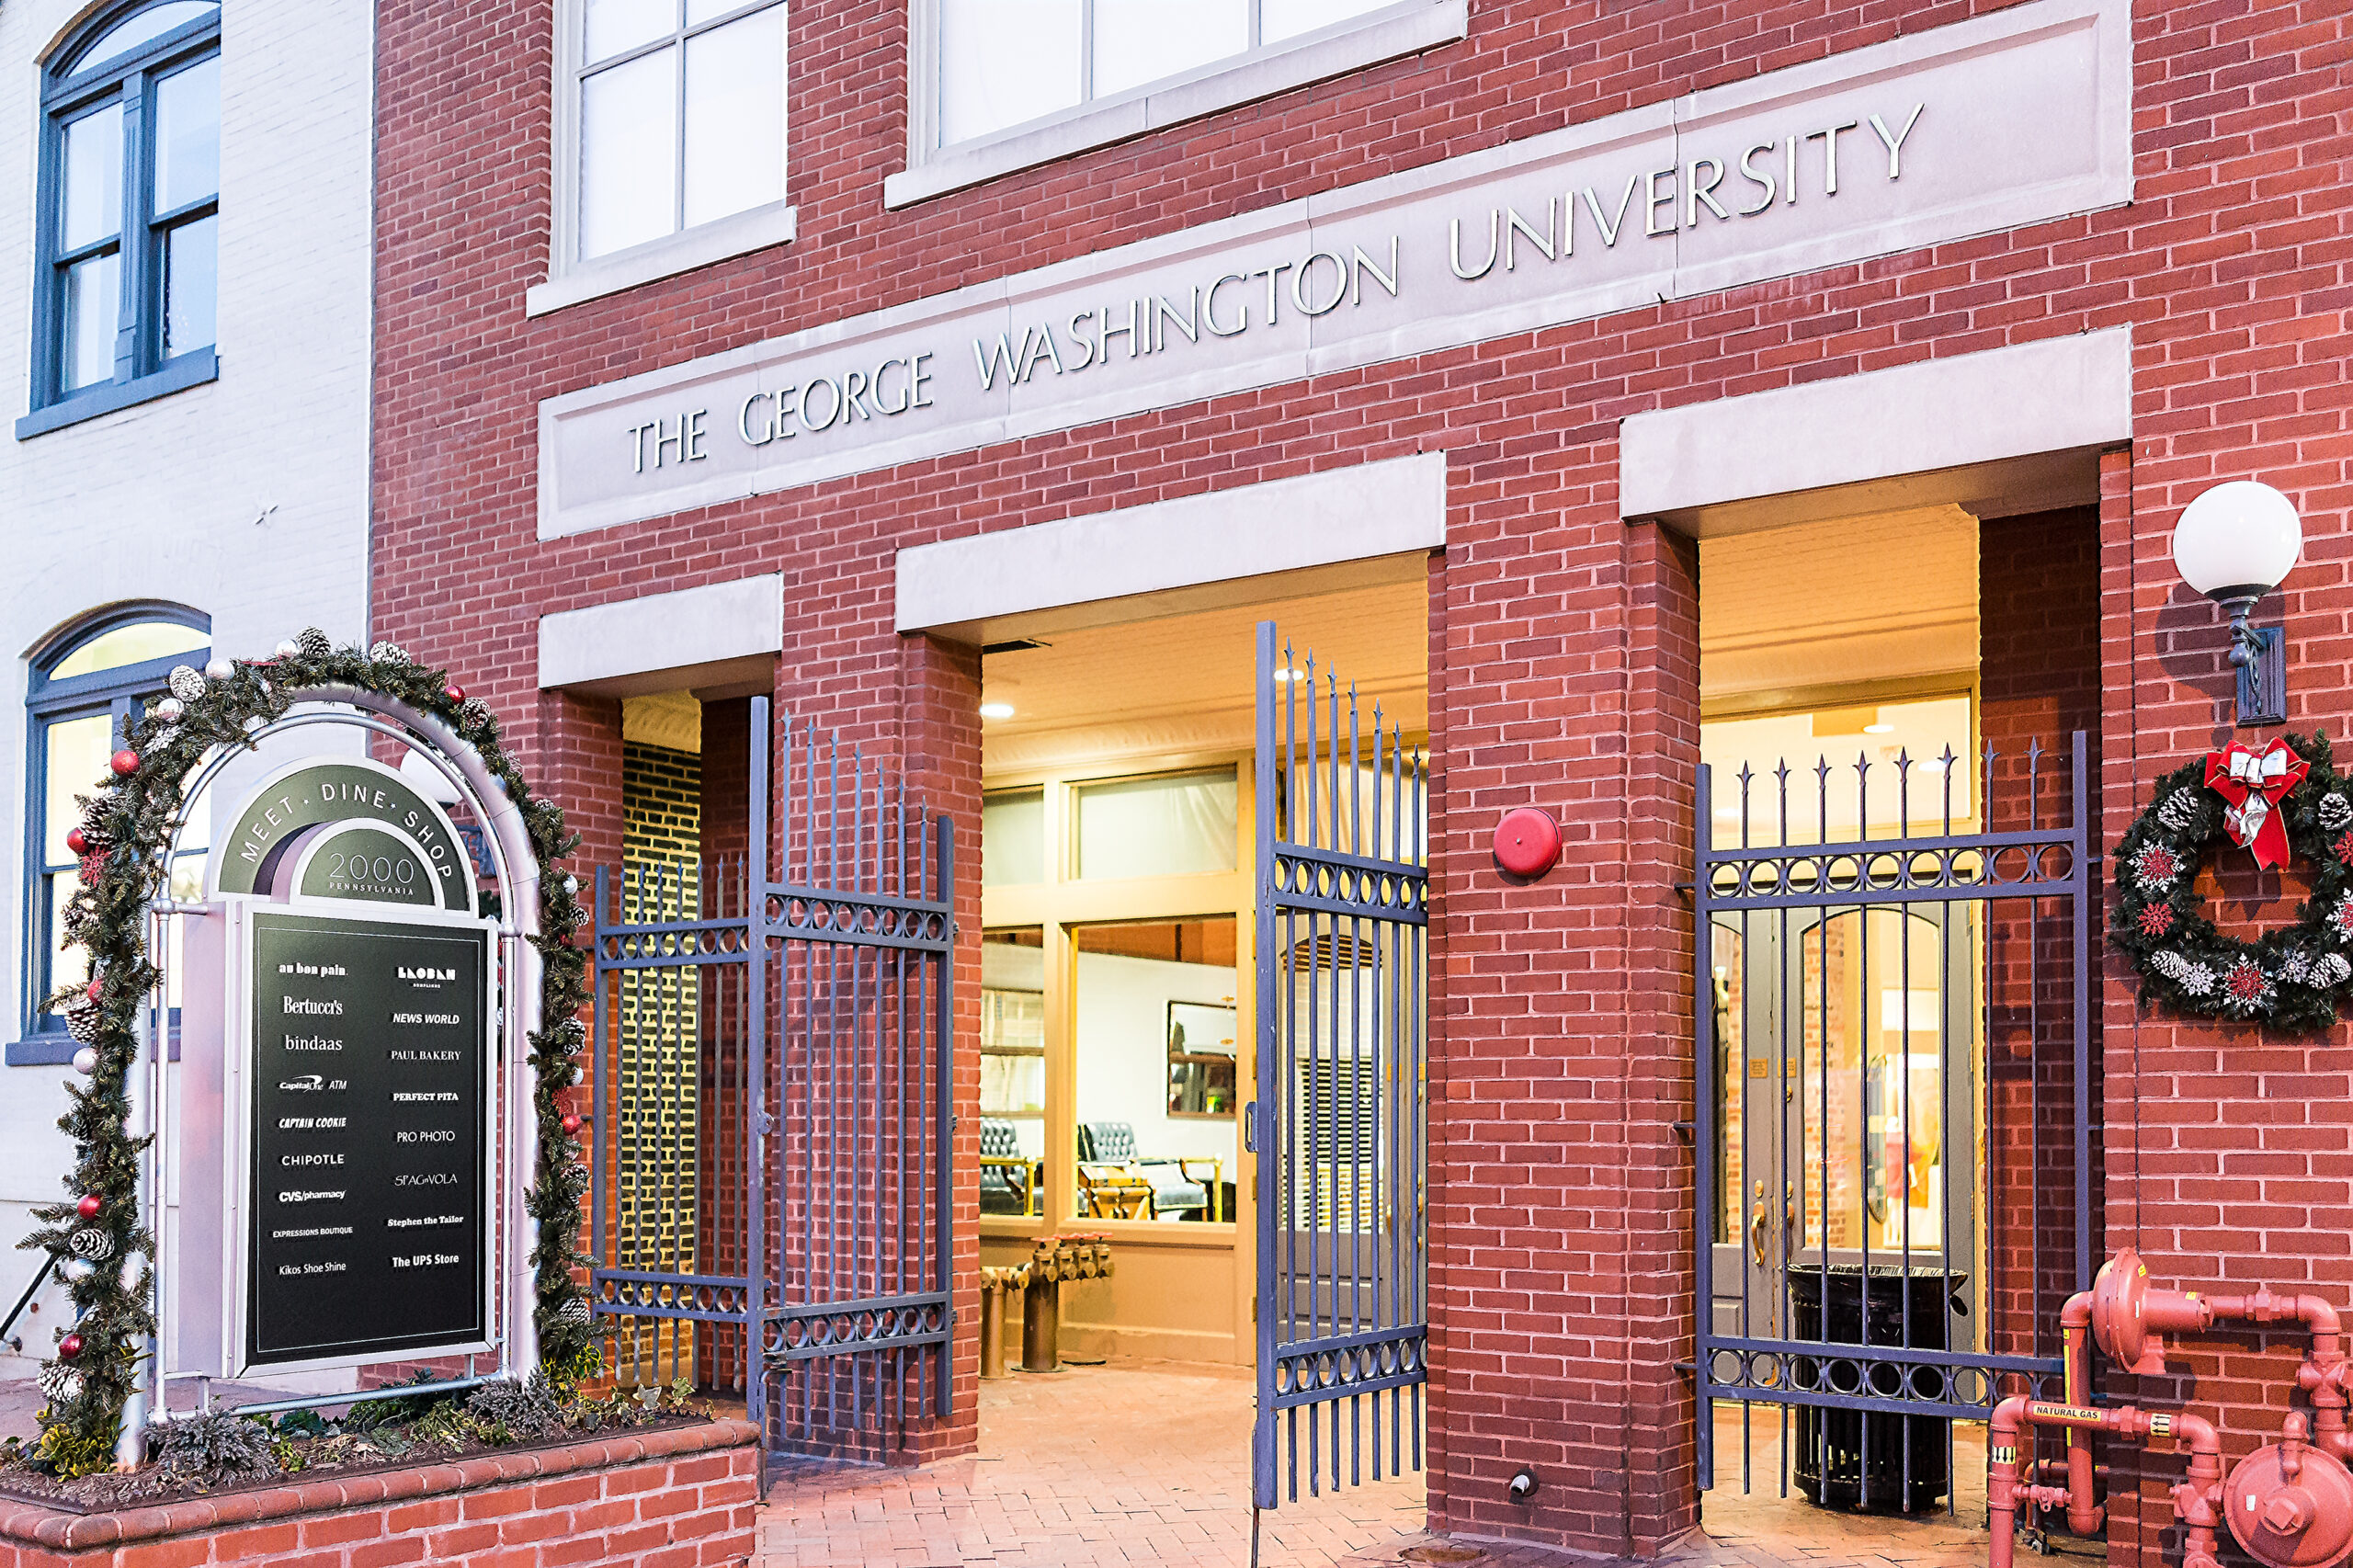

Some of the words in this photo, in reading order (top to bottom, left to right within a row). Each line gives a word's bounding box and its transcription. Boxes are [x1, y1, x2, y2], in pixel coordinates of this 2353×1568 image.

[628, 407, 708, 474] THE
[737, 352, 933, 448] GEORGE
[971, 233, 1399, 392] WASHINGTON
[1449, 101, 1926, 282] UNIVERSITY
[240, 796, 294, 863] MEET
[322, 783, 386, 810] DINE
[404, 810, 452, 879] SHOP
[329, 852, 415, 883] 2000
[329, 881, 415, 896] PENNSYLVANIA
[278, 964, 294, 973] au
[296, 962, 318, 974] bon
[398, 966, 456, 981] LAOBAN
[283, 995, 343, 1016] Bertucci's
[392, 1013, 423, 1024] NEWS
[425, 1014, 460, 1025] WORLD
[285, 1034, 343, 1051] bindaas
[391, 1051, 418, 1061] PAUL
[419, 1051, 461, 1061] BAKERY
[328, 1080, 347, 1090] ATM
[392, 1093, 436, 1102] PERFECT
[437, 1092, 459, 1101] PITA
[278, 1118, 314, 1129] CAPTAIN
[315, 1117, 347, 1128] COOKIE
[396, 1131, 417, 1142] PRO
[419, 1131, 456, 1142] PHOTO
[281, 1153, 345, 1166] CHIPOTLE
[278, 1190, 346, 1202] CVS/pharmacy
[387, 1218, 422, 1228] Stephen
[424, 1216, 438, 1225] the
[438, 1215, 464, 1224] Tailor
[273, 1228, 319, 1238] EXPRESSIONS
[320, 1226, 353, 1235] BOUTIQUE
[392, 1256, 410, 1267] The
[412, 1255, 432, 1267] UPS
[434, 1253, 460, 1265] Store
[278, 1265, 301, 1276] Kikos
[303, 1263, 324, 1274] Shoe
[324, 1261, 347, 1272] Shine
[2036, 1406, 2077, 1417] NATURAL
[2079, 1410, 2098, 1419] GAS
